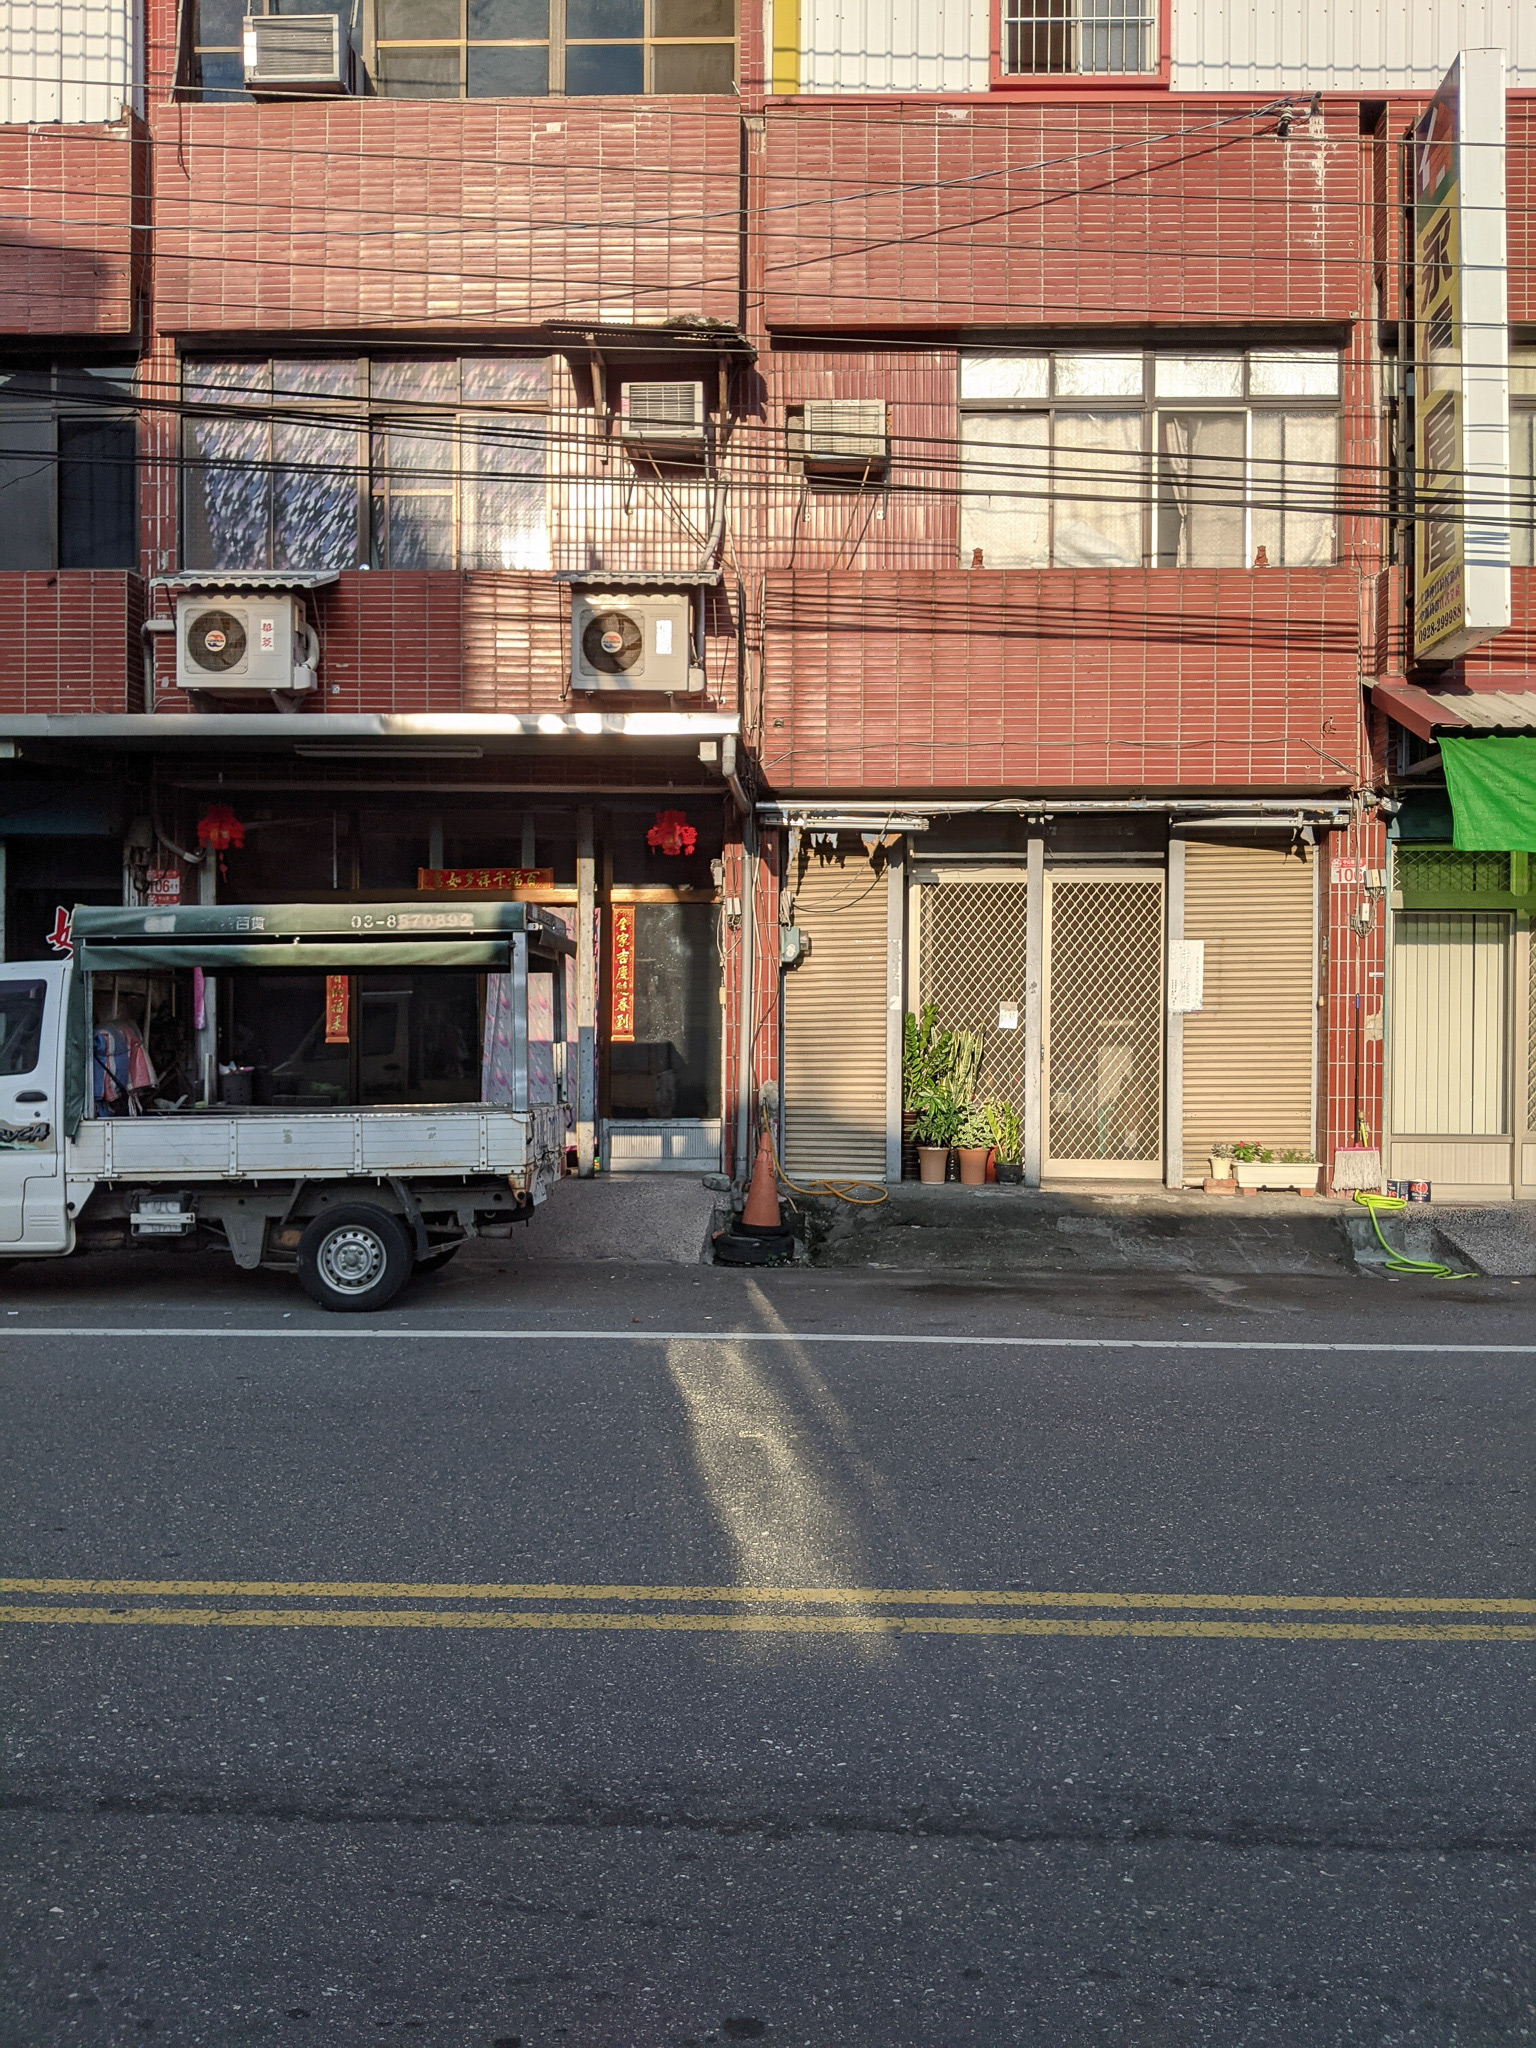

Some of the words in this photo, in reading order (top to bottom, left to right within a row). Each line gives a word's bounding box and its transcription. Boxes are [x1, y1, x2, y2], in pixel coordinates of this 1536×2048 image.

[1418, 604, 1462, 644] 0928-299988
[236, 916, 265, 931] 百貨
[351, 914, 473, 929] 03-8570892
